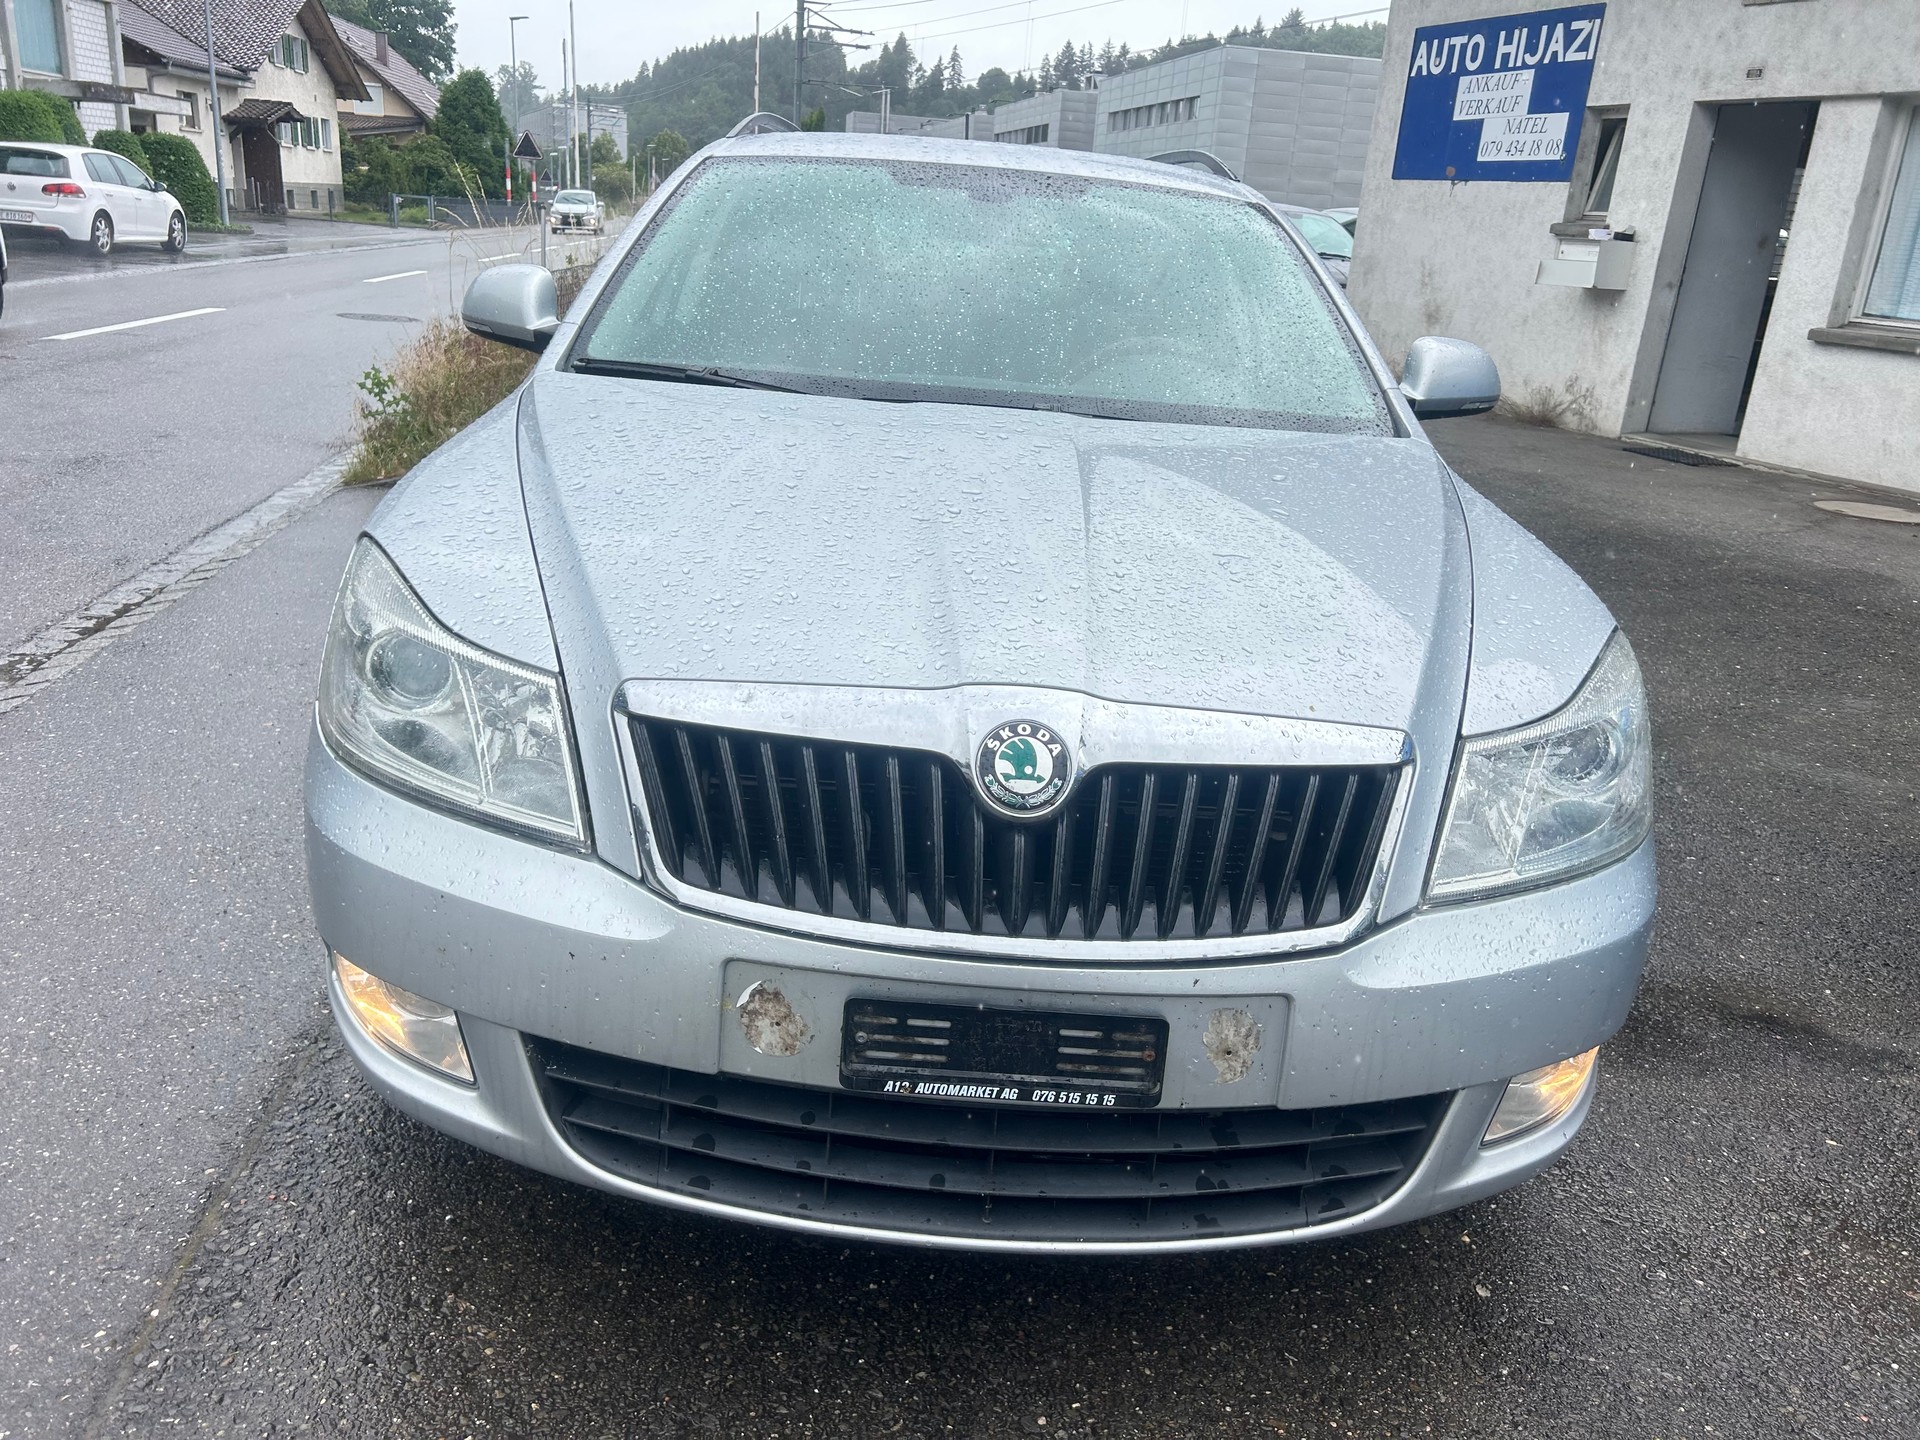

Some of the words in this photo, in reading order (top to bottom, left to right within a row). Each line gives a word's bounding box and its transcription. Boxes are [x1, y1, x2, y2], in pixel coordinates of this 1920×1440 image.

[1410, 34, 1485, 76] AUTO
[1494, 19, 1601, 69] HIJAZI
[1459, 95, 1523, 116] VERKAUF
[1503, 117, 1548, 135] NATEL
[1480, 140, 1503, 157] 079
[1505, 139, 1526, 157] 434
[1528, 138, 1542, 156] 18
[1545, 138, 1562, 156] 08
[914, 1082, 1000, 1099] AUTOMARKET
[1000, 1087, 1019, 1100] AG
[1032, 1089, 1056, 1102] 076
[1058, 1091, 1081, 1104] 515
[1085, 1093, 1099, 1105] 15
[1102, 1094, 1116, 1106] 15
